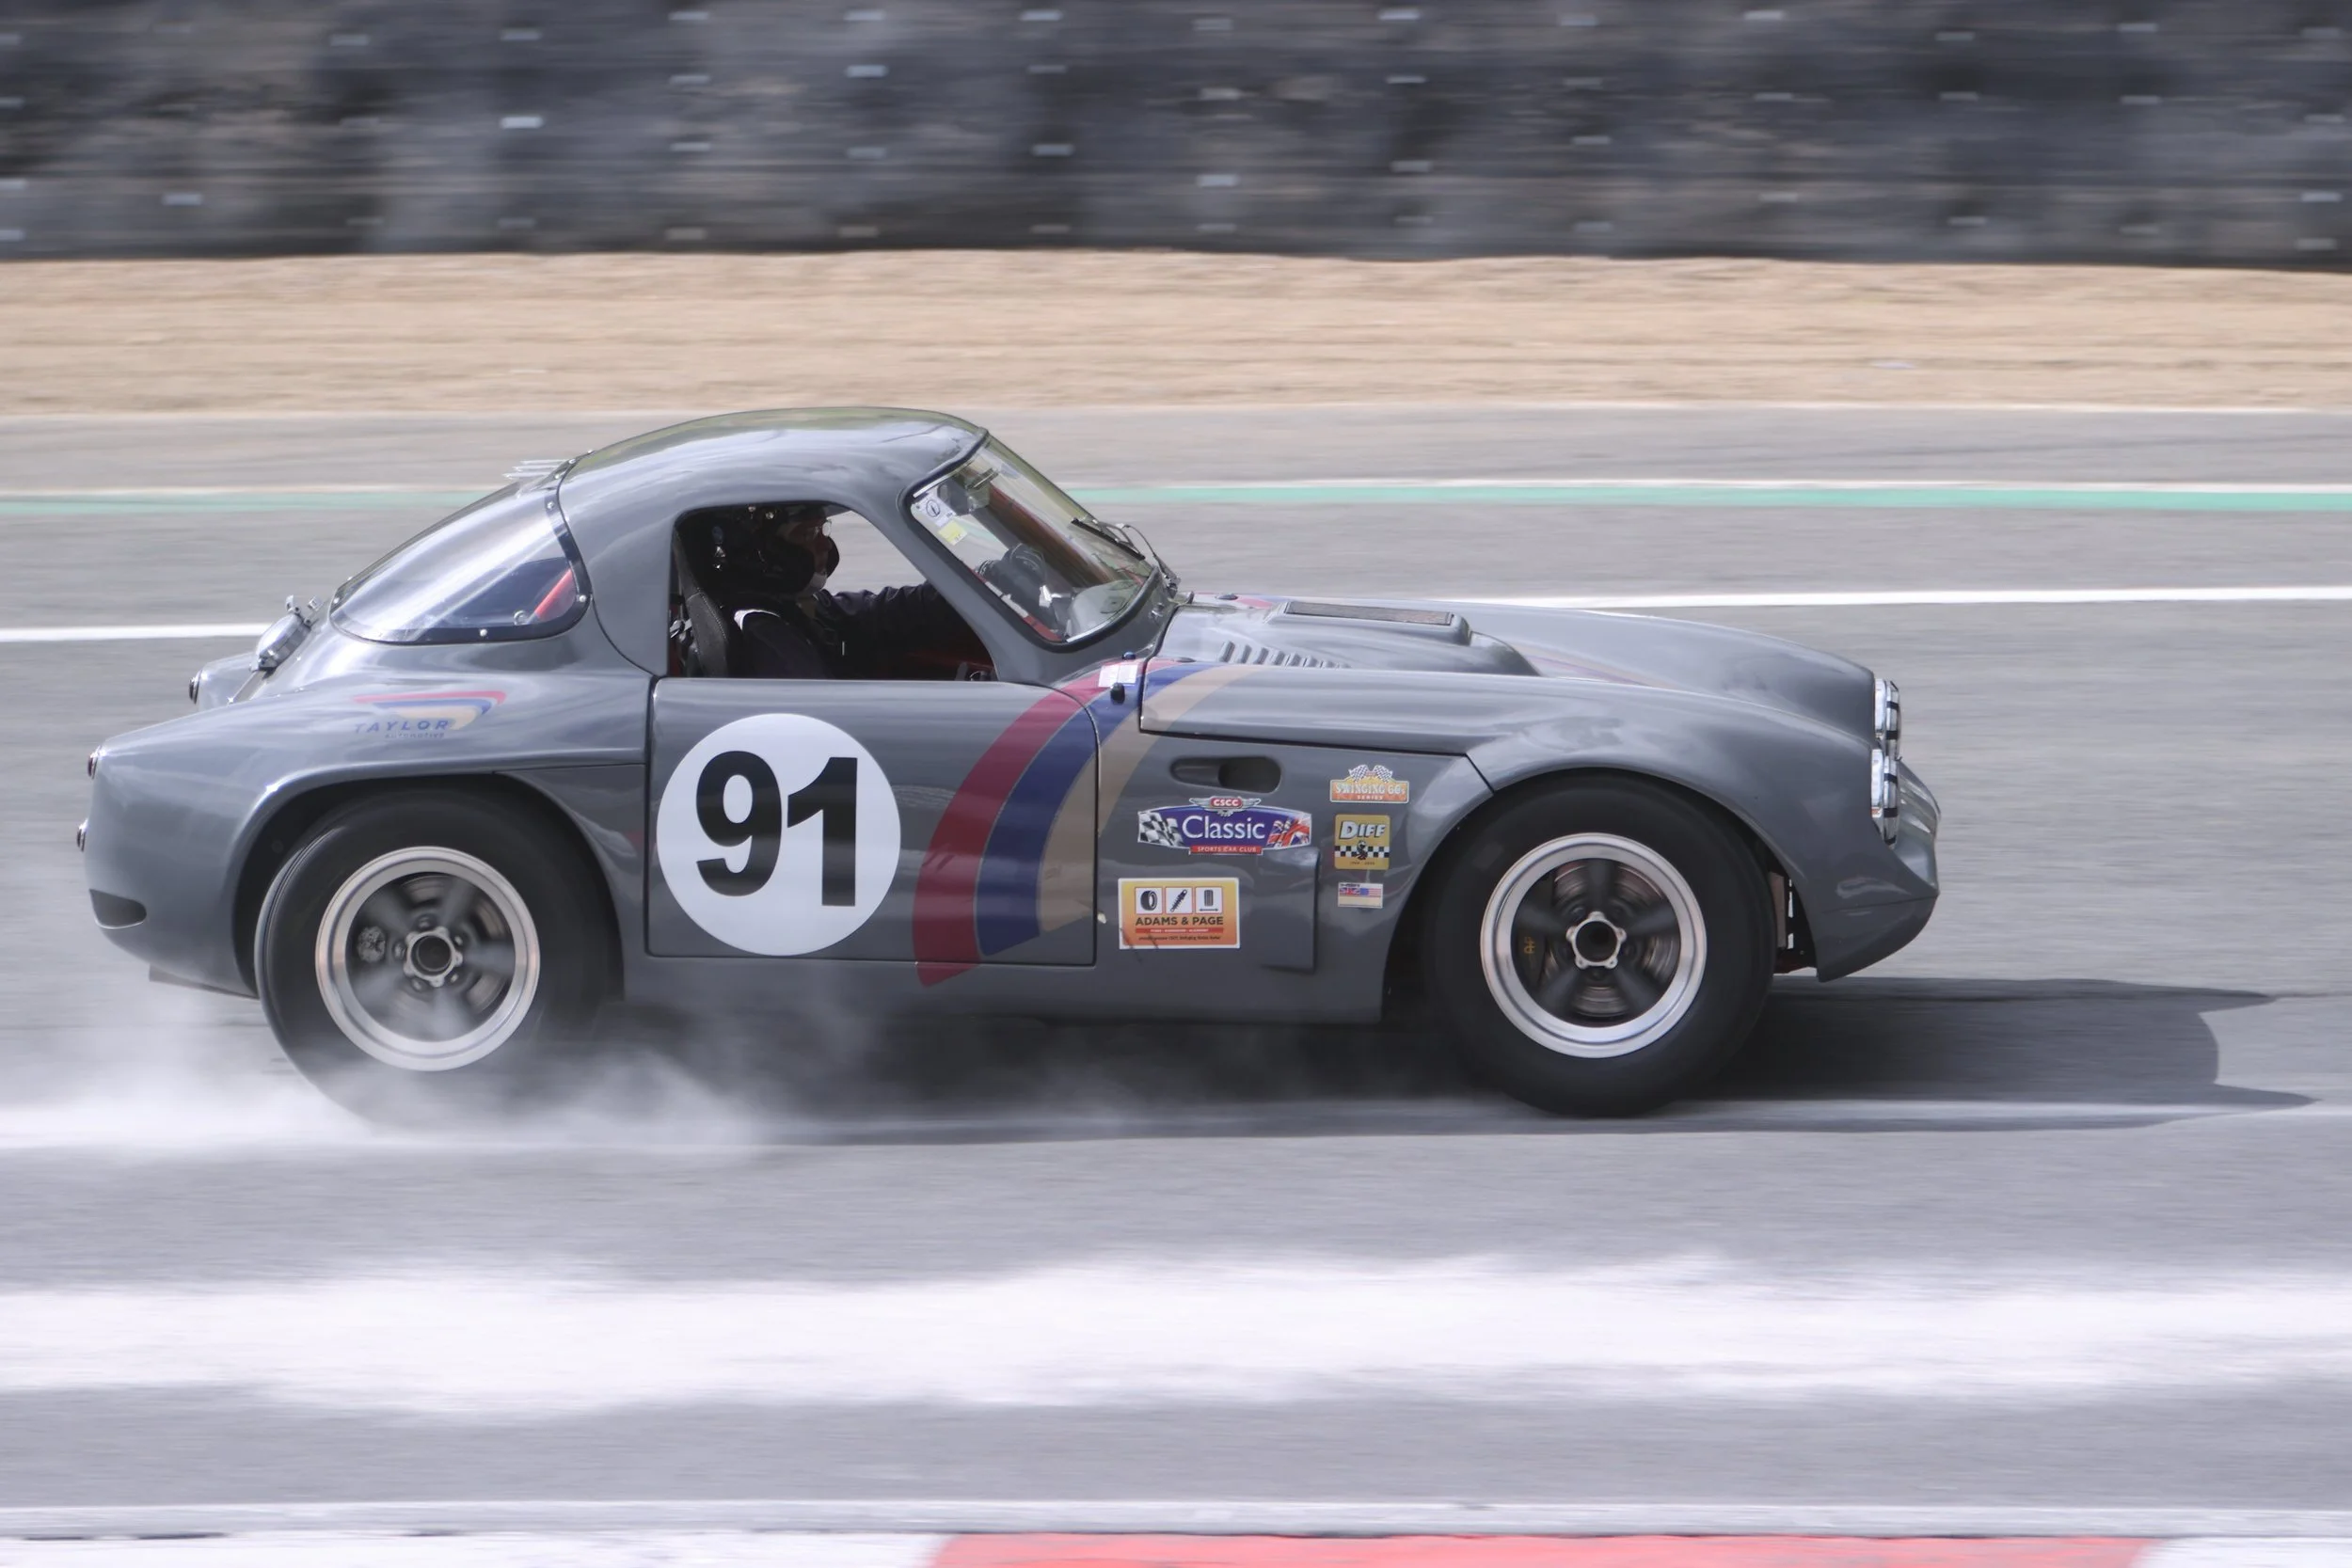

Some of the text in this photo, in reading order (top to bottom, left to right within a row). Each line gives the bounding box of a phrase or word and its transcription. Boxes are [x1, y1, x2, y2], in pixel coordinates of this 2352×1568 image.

[355, 720, 449, 734] TAYLOR
[1336, 783, 1386, 794] SWINGING
[1213, 799, 1240, 807] CSCC
[695, 750, 858, 907] 91
[1182, 816, 1265, 839] Classic
[1339, 820, 1386, 840] DIFF
[1136, 916, 1224, 926] ADAMS & PAGE
